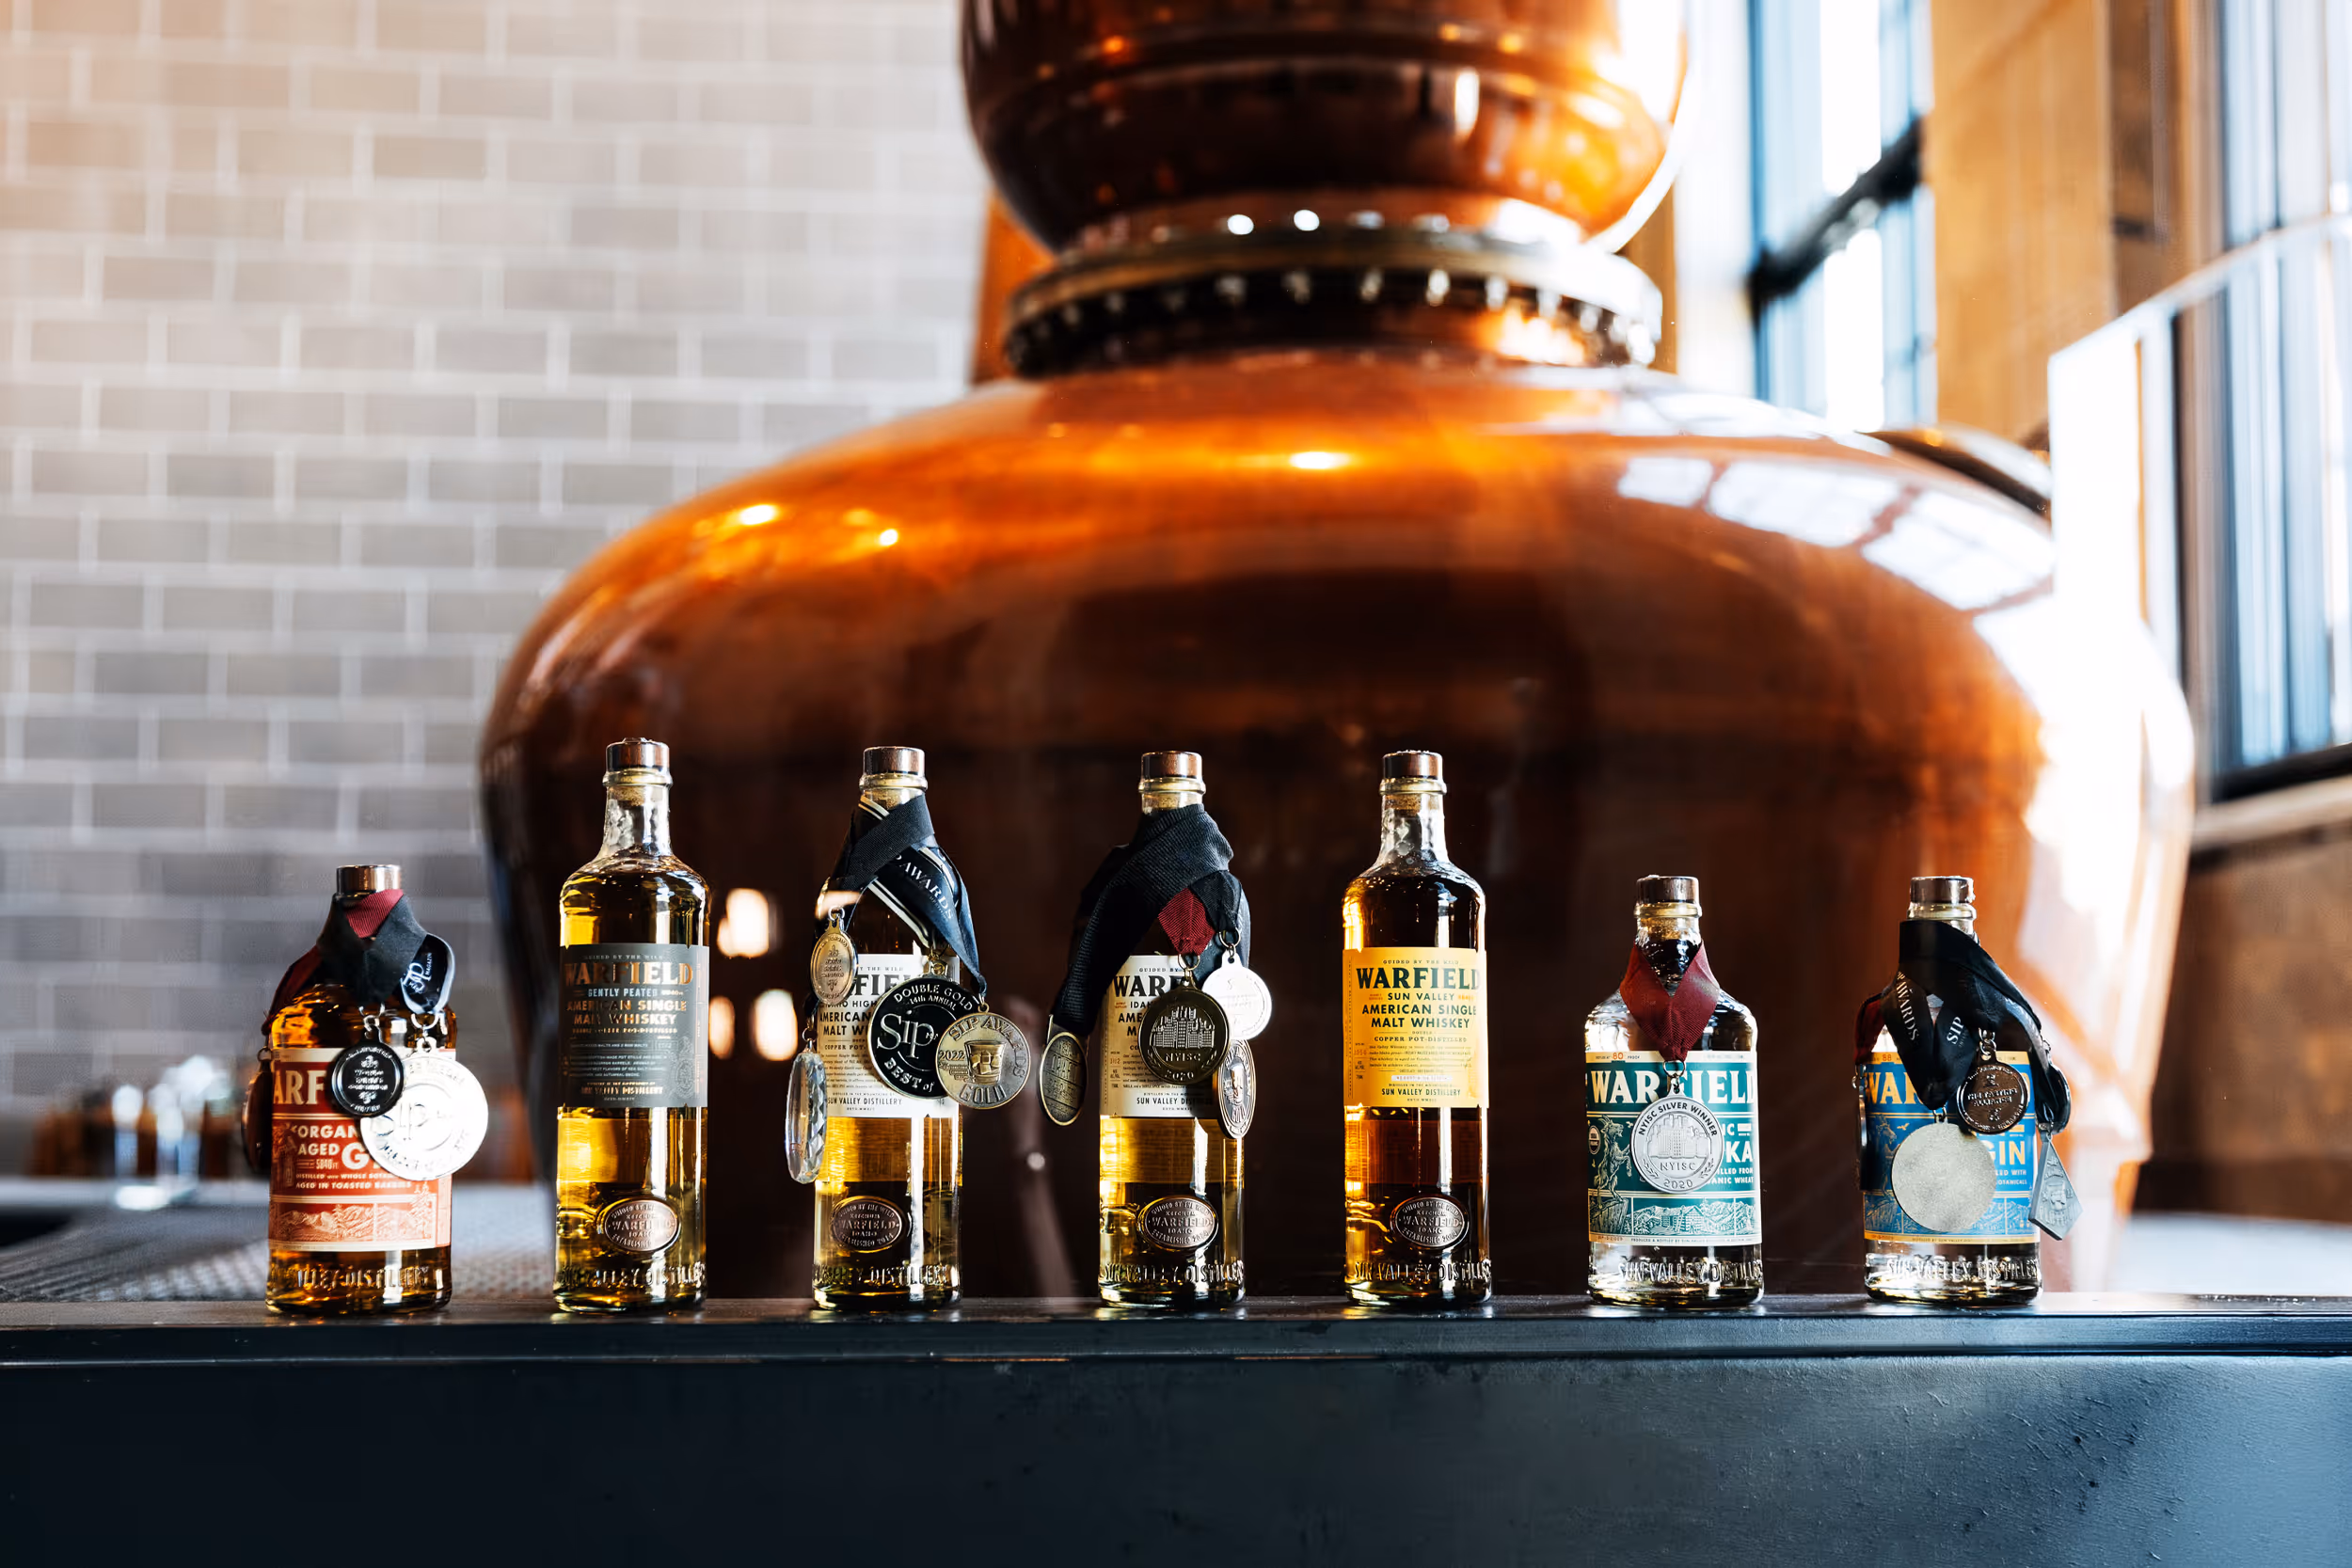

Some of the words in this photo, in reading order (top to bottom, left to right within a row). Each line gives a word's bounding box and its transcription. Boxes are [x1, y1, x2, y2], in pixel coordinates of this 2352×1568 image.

[900, 862, 952, 920] AWARDS
[564, 961, 693, 986] WARFIELD
[1356, 967, 1480, 990] WARFIELD
[587, 988, 620, 997] GENTLY
[623, 988, 659, 997] PEATED
[894, 983, 940, 1004] DOUBLE
[944, 987, 973, 1011] GOLD
[1388, 992, 1410, 1001] SUN
[1416, 992, 1455, 1001] VALLEY
[638, 1000, 687, 1011] SINGLE
[928, 995, 957, 1011] ANNUAL
[1361, 1004, 1432, 1015] AMERICAN
[1438, 1004, 1477, 1016] SINGLE
[609, 1013, 677, 1025] WHISKEY
[819, 1011, 872, 1022] AMERICAN
[1371, 1017, 1406, 1028] MALT
[1410, 1017, 1470, 1029] WHISKEY
[823, 1025, 847, 1036] MALT
[1946, 1016, 1964, 1045] SIP
[948, 1016, 979, 1041] SIP
[980, 1016, 1027, 1078] AWARDS
[939, 1050, 966, 1061] 2022
[1165, 1053, 1201, 1062] NYISC
[1613, 1052, 1624, 1060] 80
[884, 1057, 922, 1089] BEST
[922, 1081, 936, 1092] of
[839, 1097, 861, 1105] VALLEY
[863, 1097, 902, 1105] DISTILLERY
[1638, 1111, 1658, 1136] NYISC
[1658, 1101, 1688, 1114] SILVER
[1690, 1104, 1718, 1136] WINNER
[297, 1125, 358, 1139] ORGAN
[297, 1143, 341, 1156] AGED
[1660, 1162, 1696, 1171] NYISC
[295, 1181, 316, 1190] AGED
[1663, 1179, 1693, 1189] 2020
